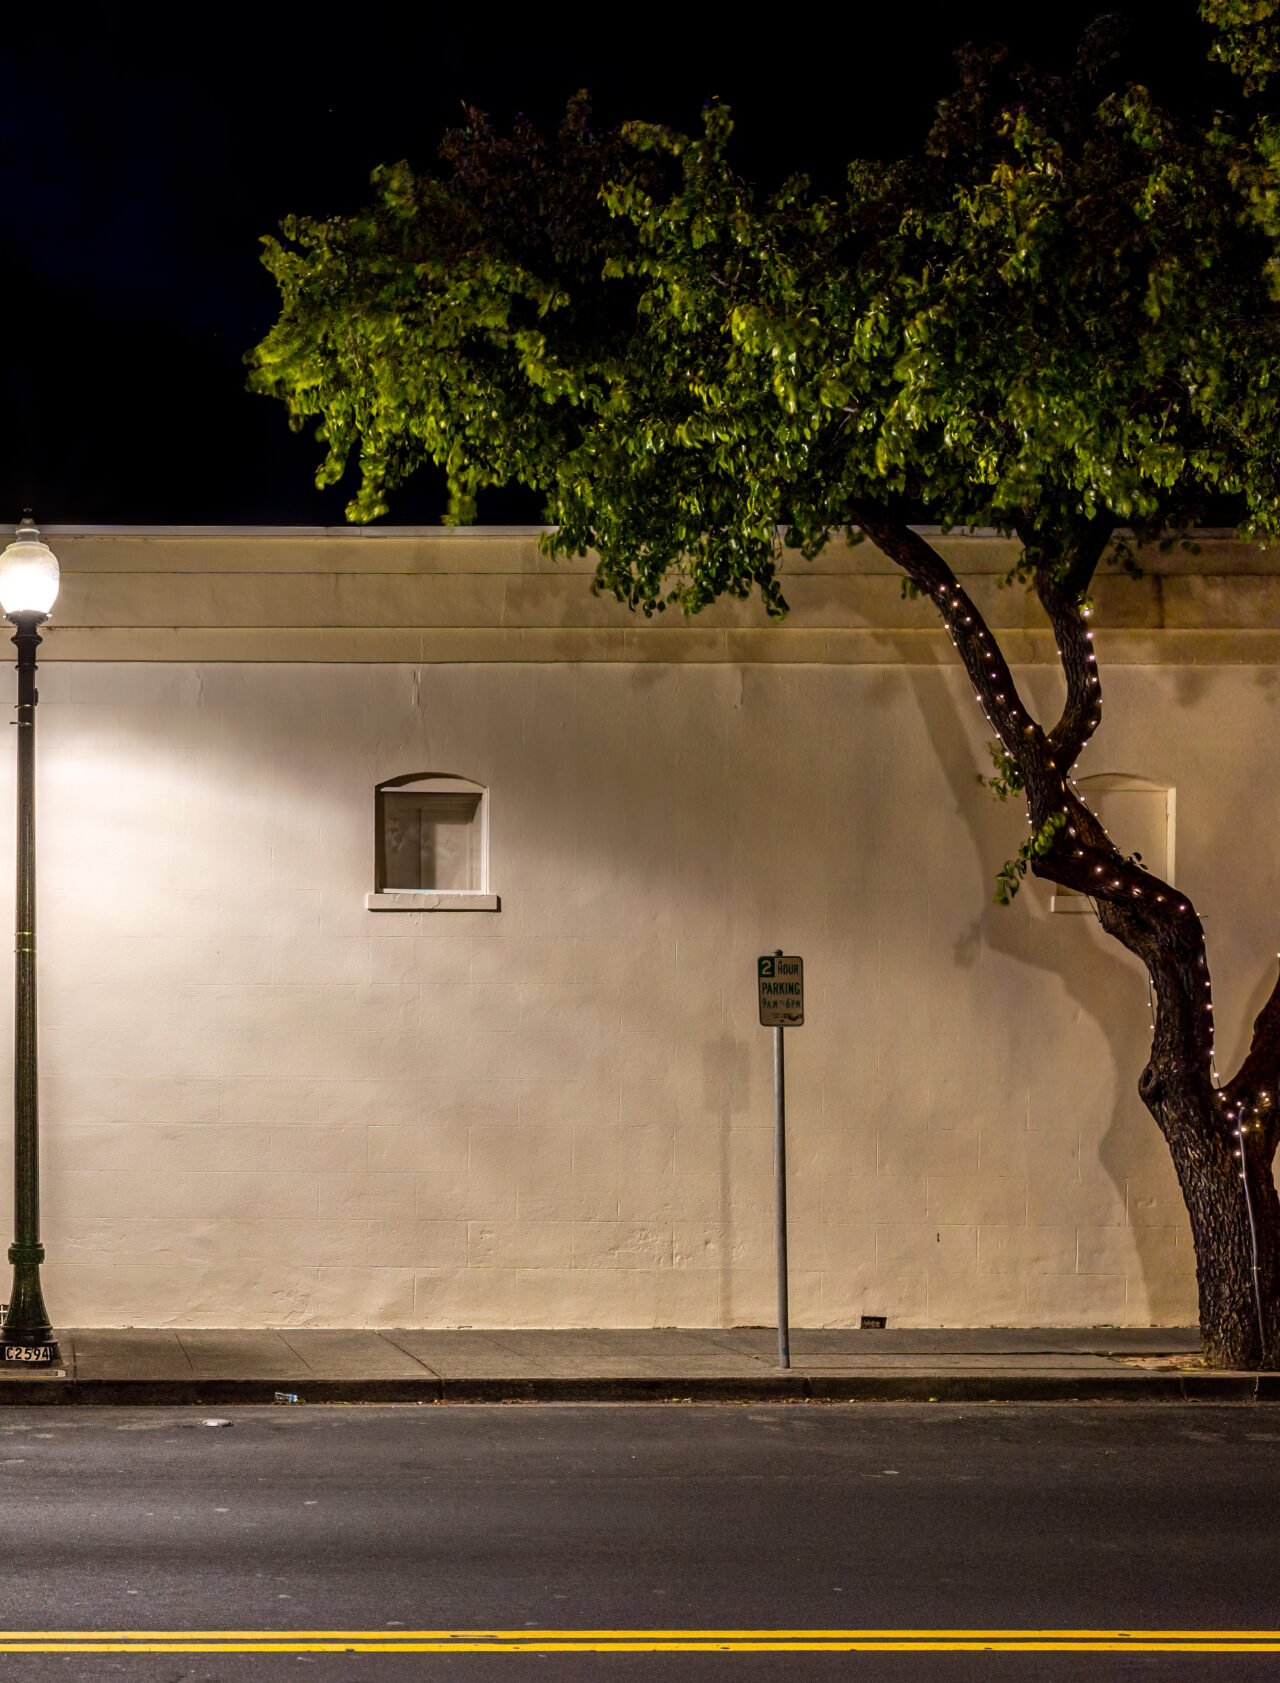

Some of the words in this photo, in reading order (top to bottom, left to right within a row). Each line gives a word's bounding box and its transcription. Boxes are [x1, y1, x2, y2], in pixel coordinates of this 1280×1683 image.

[761, 960, 772, 975] 2
[777, 960, 799, 975] HOUR
[762, 982, 801, 995] PARKING
[6, 1347, 49, 1360] C2594
